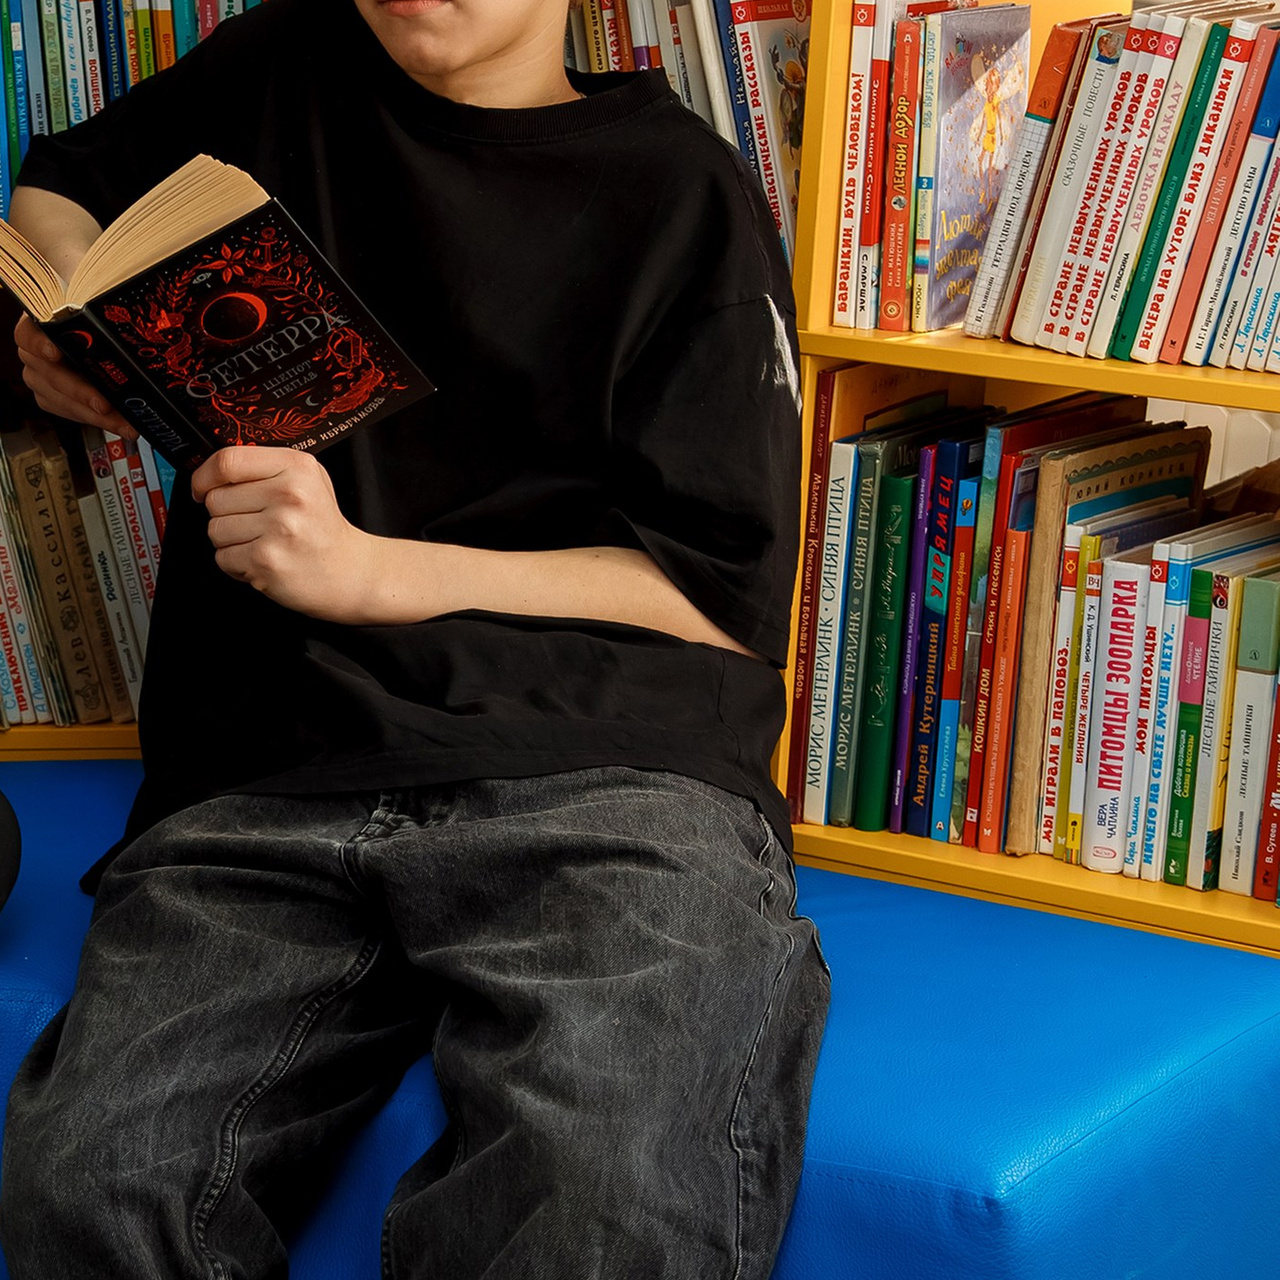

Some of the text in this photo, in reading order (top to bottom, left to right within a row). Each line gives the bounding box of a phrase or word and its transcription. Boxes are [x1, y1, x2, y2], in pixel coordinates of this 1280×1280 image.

[737, 30, 763, 108] РАССКАЗЫ
[186, 305, 351, 399] СЕТЕРРА
[928, 474, 954, 600] УПРЯМЕЦ
[806, 476, 845, 789] МОРИС МЕТЕРЛИНК СИНЯЯ ПТИЦА
[1096, 579, 1138, 791] ПИТОМЦЫ ЗООПАРКА
[1200, 621, 1223, 757] ЛЕСНЫЕ ТАЙНИЧКИ
[911, 622, 941, 806] Андрей Кутерницкий
[1096, 803, 1108, 826] ВЕРА
[1105, 796, 1120, 839] ЧАПЛИНА
